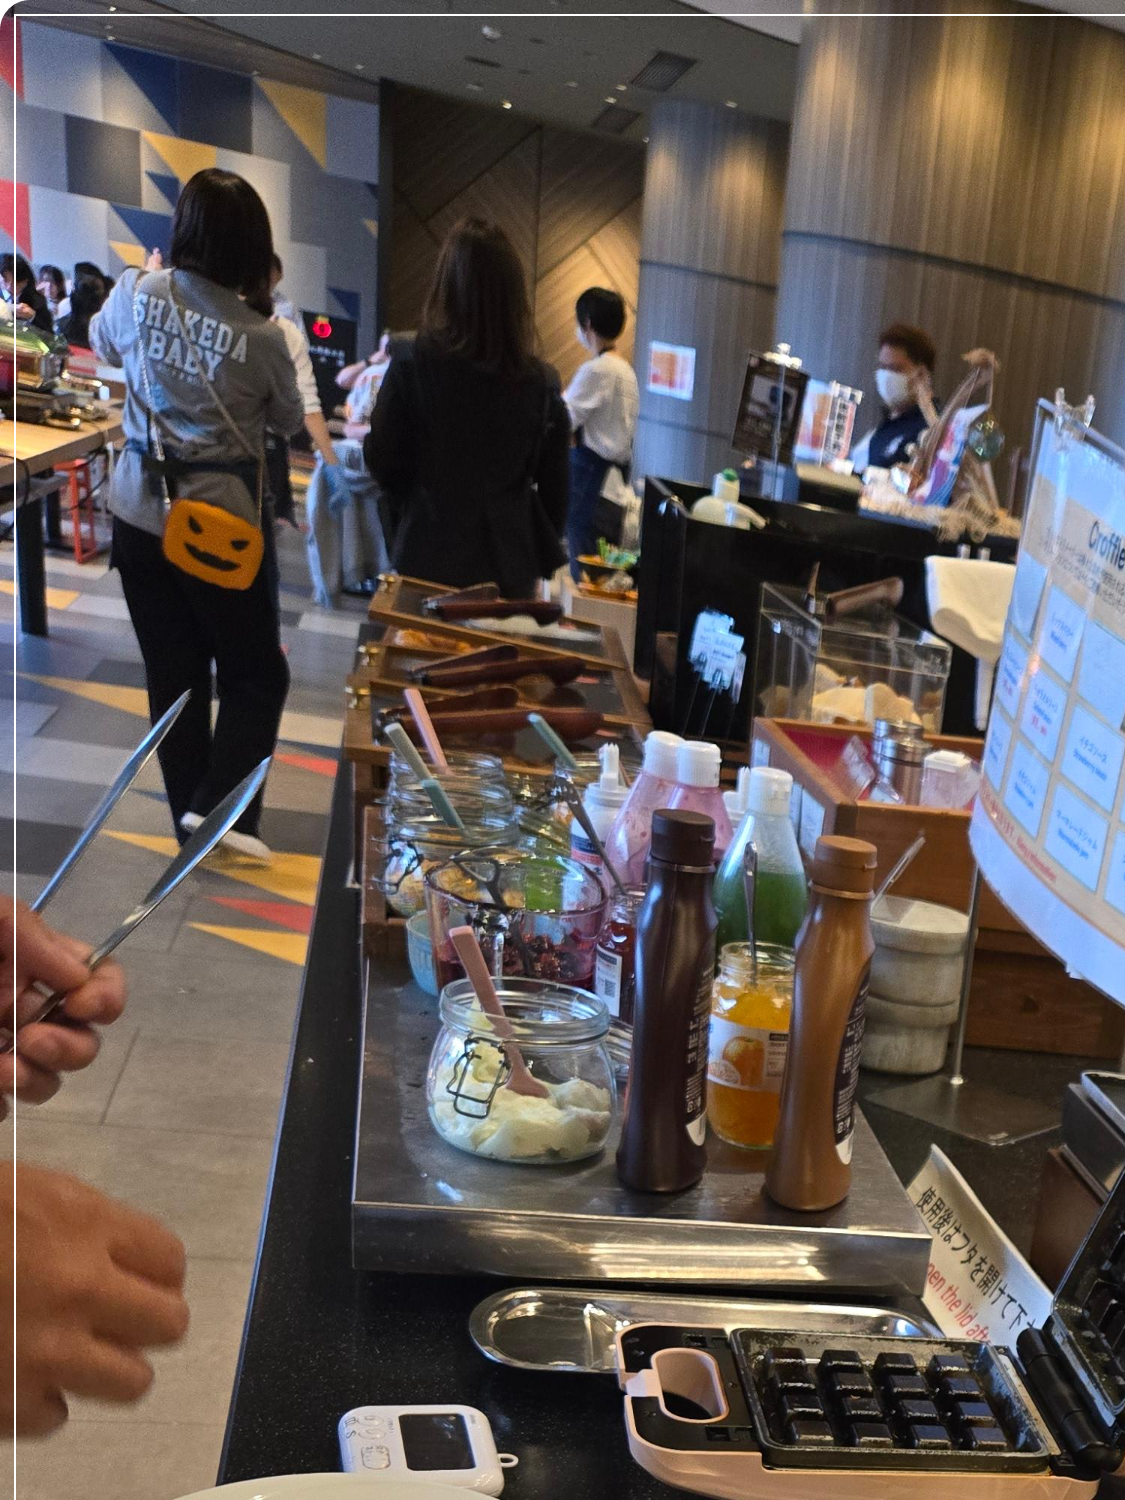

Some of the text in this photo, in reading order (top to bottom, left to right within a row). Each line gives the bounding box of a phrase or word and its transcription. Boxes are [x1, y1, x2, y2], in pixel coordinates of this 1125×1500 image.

[148, 328, 222, 382] BABY
[916, 1186, 1036, 1330] 使用後はフタを開けて下
[940, 1284, 962, 1313] the
[954, 1303, 978, 1328] lid
